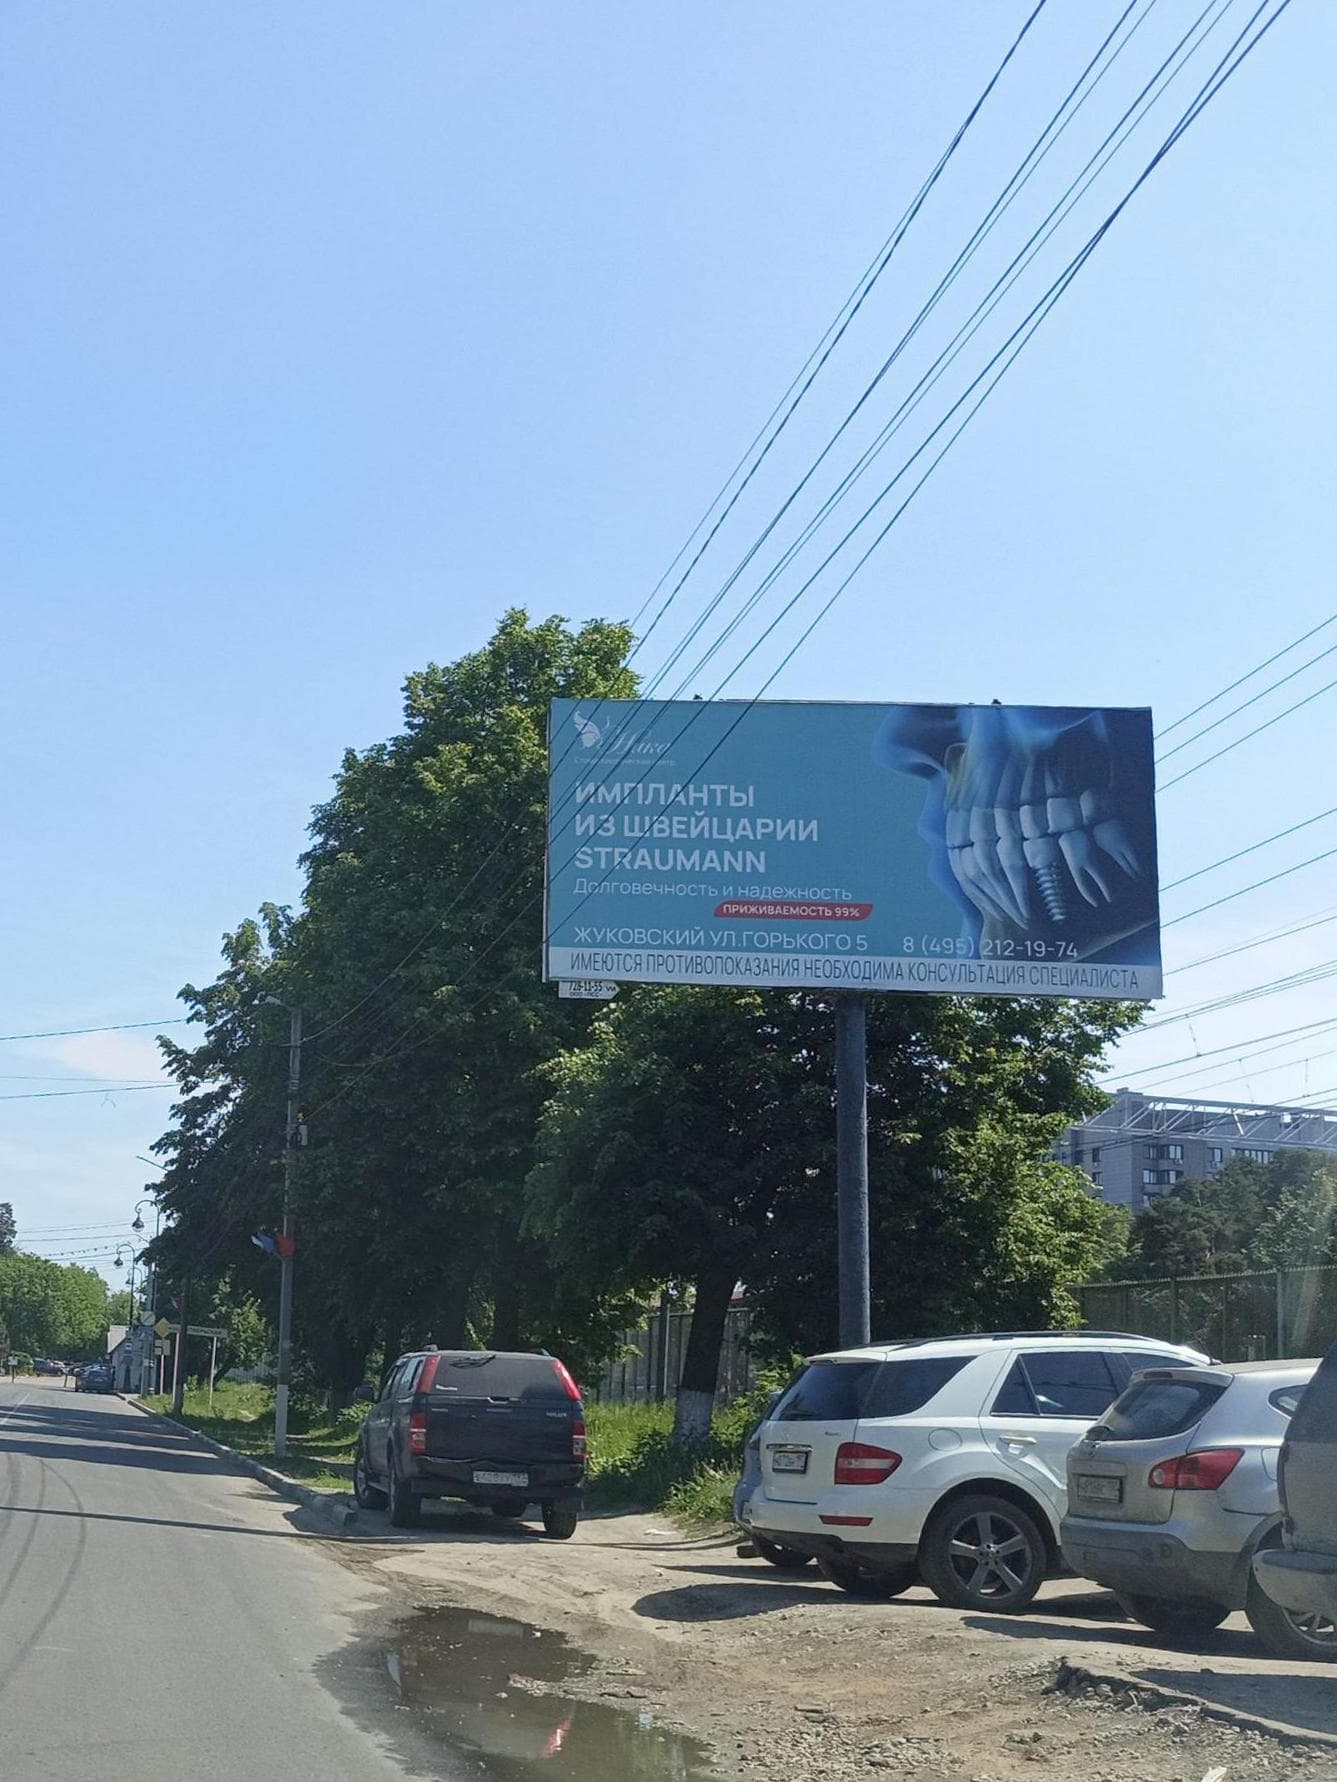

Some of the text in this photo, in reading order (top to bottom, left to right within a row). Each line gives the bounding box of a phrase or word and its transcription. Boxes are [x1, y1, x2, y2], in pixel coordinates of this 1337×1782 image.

[575, 782, 755, 807] ИМПЛАНТЫ
[575, 810, 819, 843] ИЗ ШВЕЙЦАРИИ
[574, 847, 765, 873] STRAUMANN
[573, 878, 853, 901] Долговечность и надежность
[723, 904, 860, 918] ПРИЖИВАЕМОСТЬ 99%
[574, 926, 869, 951] ЖУКОВСКИЙ УЛ.ГОРЬКОГО 5
[903, 934, 1078, 958] 8 (495) 212-19-74
[570, 953, 1139, 989] ИМЕЮТСЯ ПРОТИВОПОКАЗАНИЯ НЕОБХОДИМА КОНСУЛЬТАЦИЯ СПЕЦИАЛИСТА
